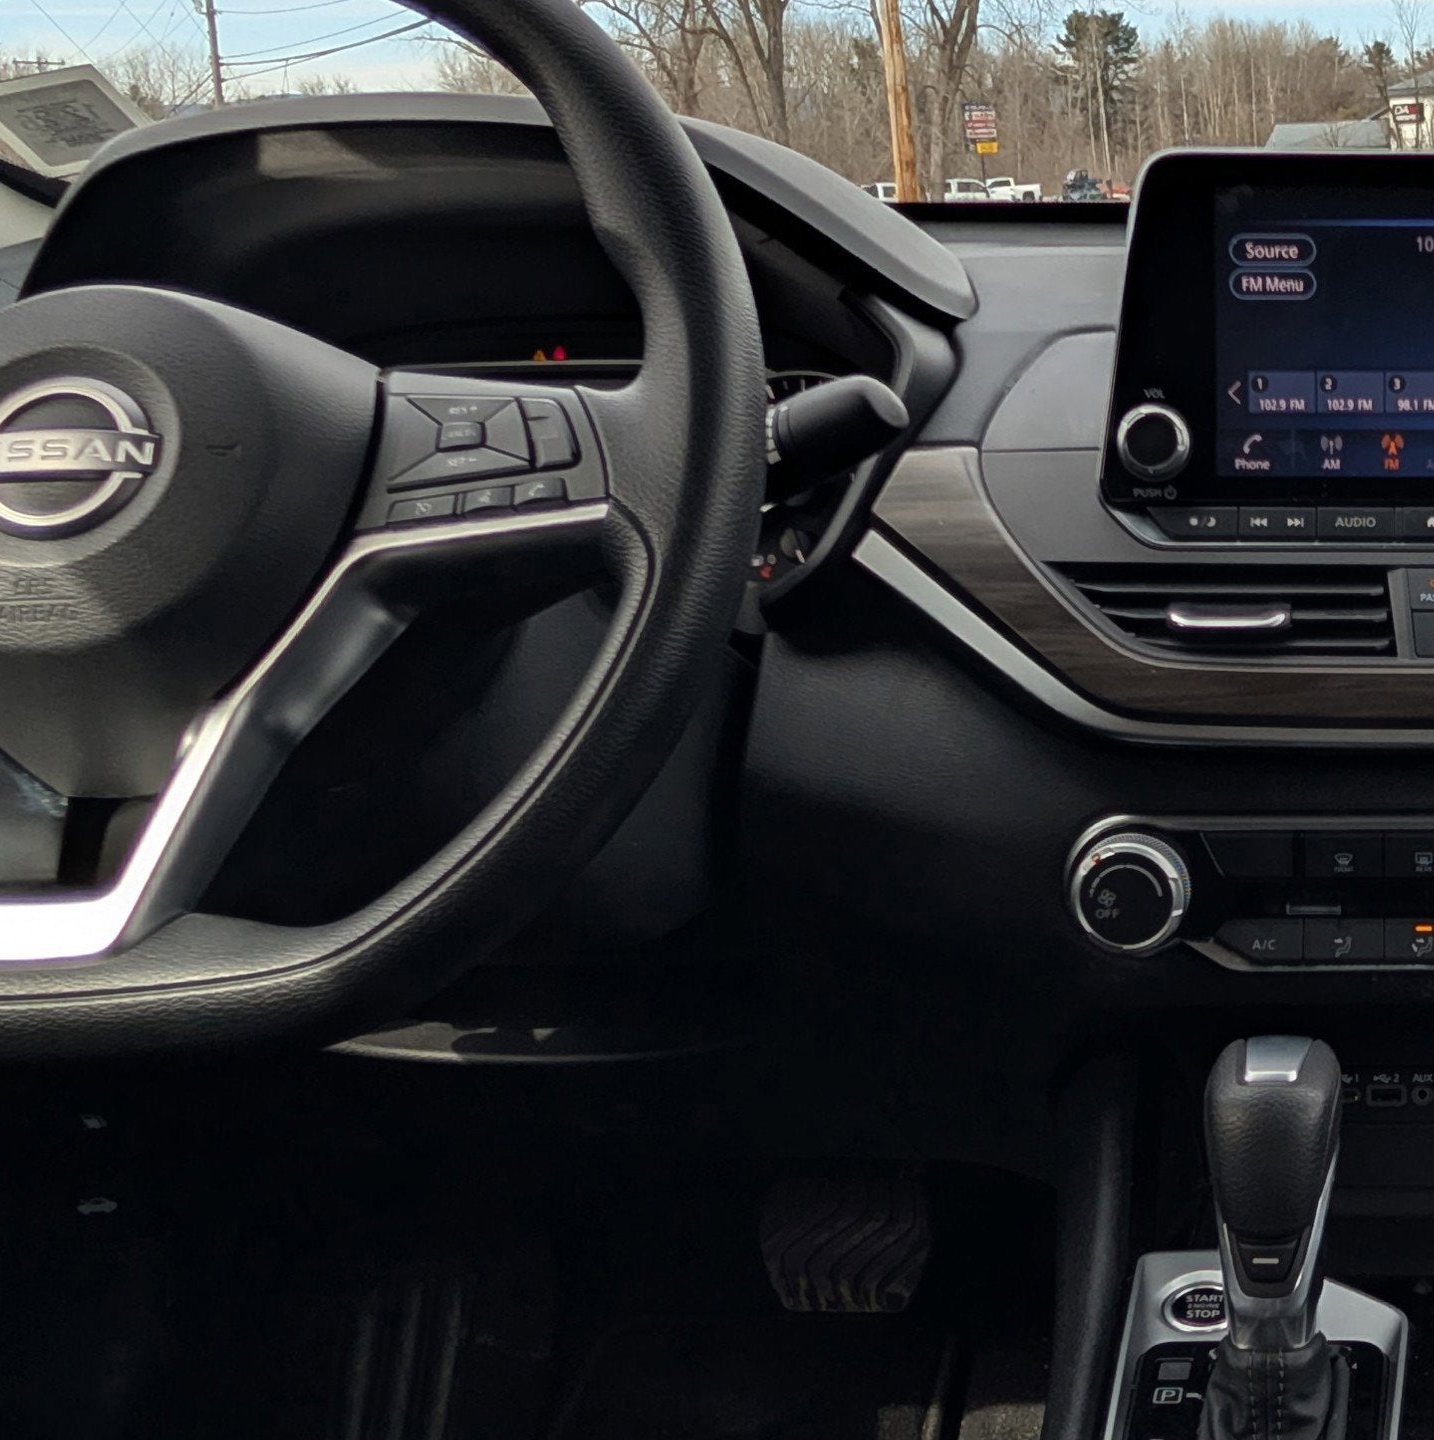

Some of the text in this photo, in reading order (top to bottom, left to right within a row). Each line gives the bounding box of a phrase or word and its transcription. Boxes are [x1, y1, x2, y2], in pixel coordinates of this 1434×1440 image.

[1245, 241, 1299, 259] Source
[1241, 276, 1304, 292] FM Menu
[1256, 378, 1264, 390] 1
[1324, 378, 1332, 390] 2
[1394, 378, 1401, 390] 3
[1144, 388, 1165, 399] VOL
[1259, 399, 1305, 411] 102.9 FM
[1327, 399, 1373, 411] 102.9 FM
[1397, 399, 1418, 411] 98.1
[1234, 459, 1271, 471] Phone
[1323, 459, 1341, 470] AM
[1384, 459, 1400, 470] FM
[1133, 487, 1162, 499] PUSH
[1335, 516, 1377, 529] AUDIO
[1095, 907, 1120, 920] OFF
[1252, 937, 1277, 952] A/C
[1412, 1073, 1433, 1083] AUX
[1185, 1294, 1223, 1303] START
[1185, 1309, 1221, 1319] STOP
[1160, 1389, 1178, 1403] P
